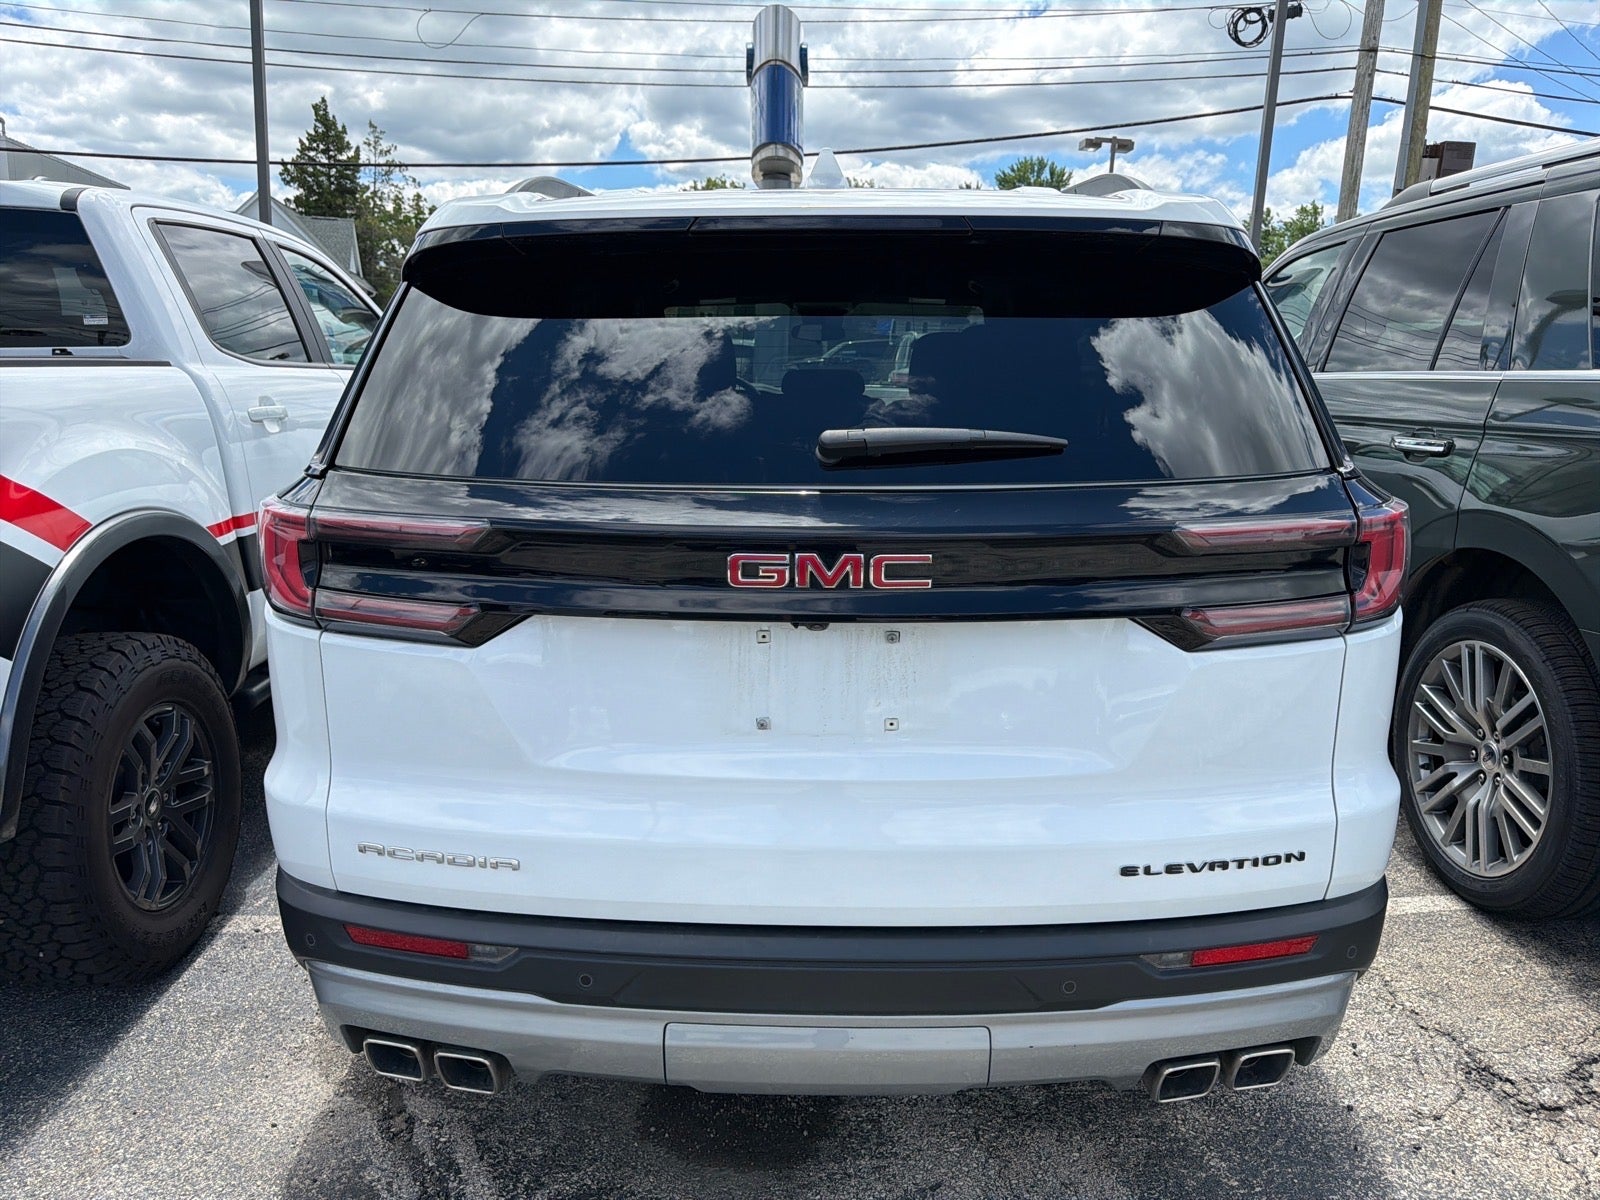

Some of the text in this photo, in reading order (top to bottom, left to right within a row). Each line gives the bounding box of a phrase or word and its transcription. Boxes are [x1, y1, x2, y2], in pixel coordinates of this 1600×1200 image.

[727, 553, 933, 589] GMC
[357, 840, 521, 872] ACADIA
[1119, 850, 1307, 877] ELEVATION
